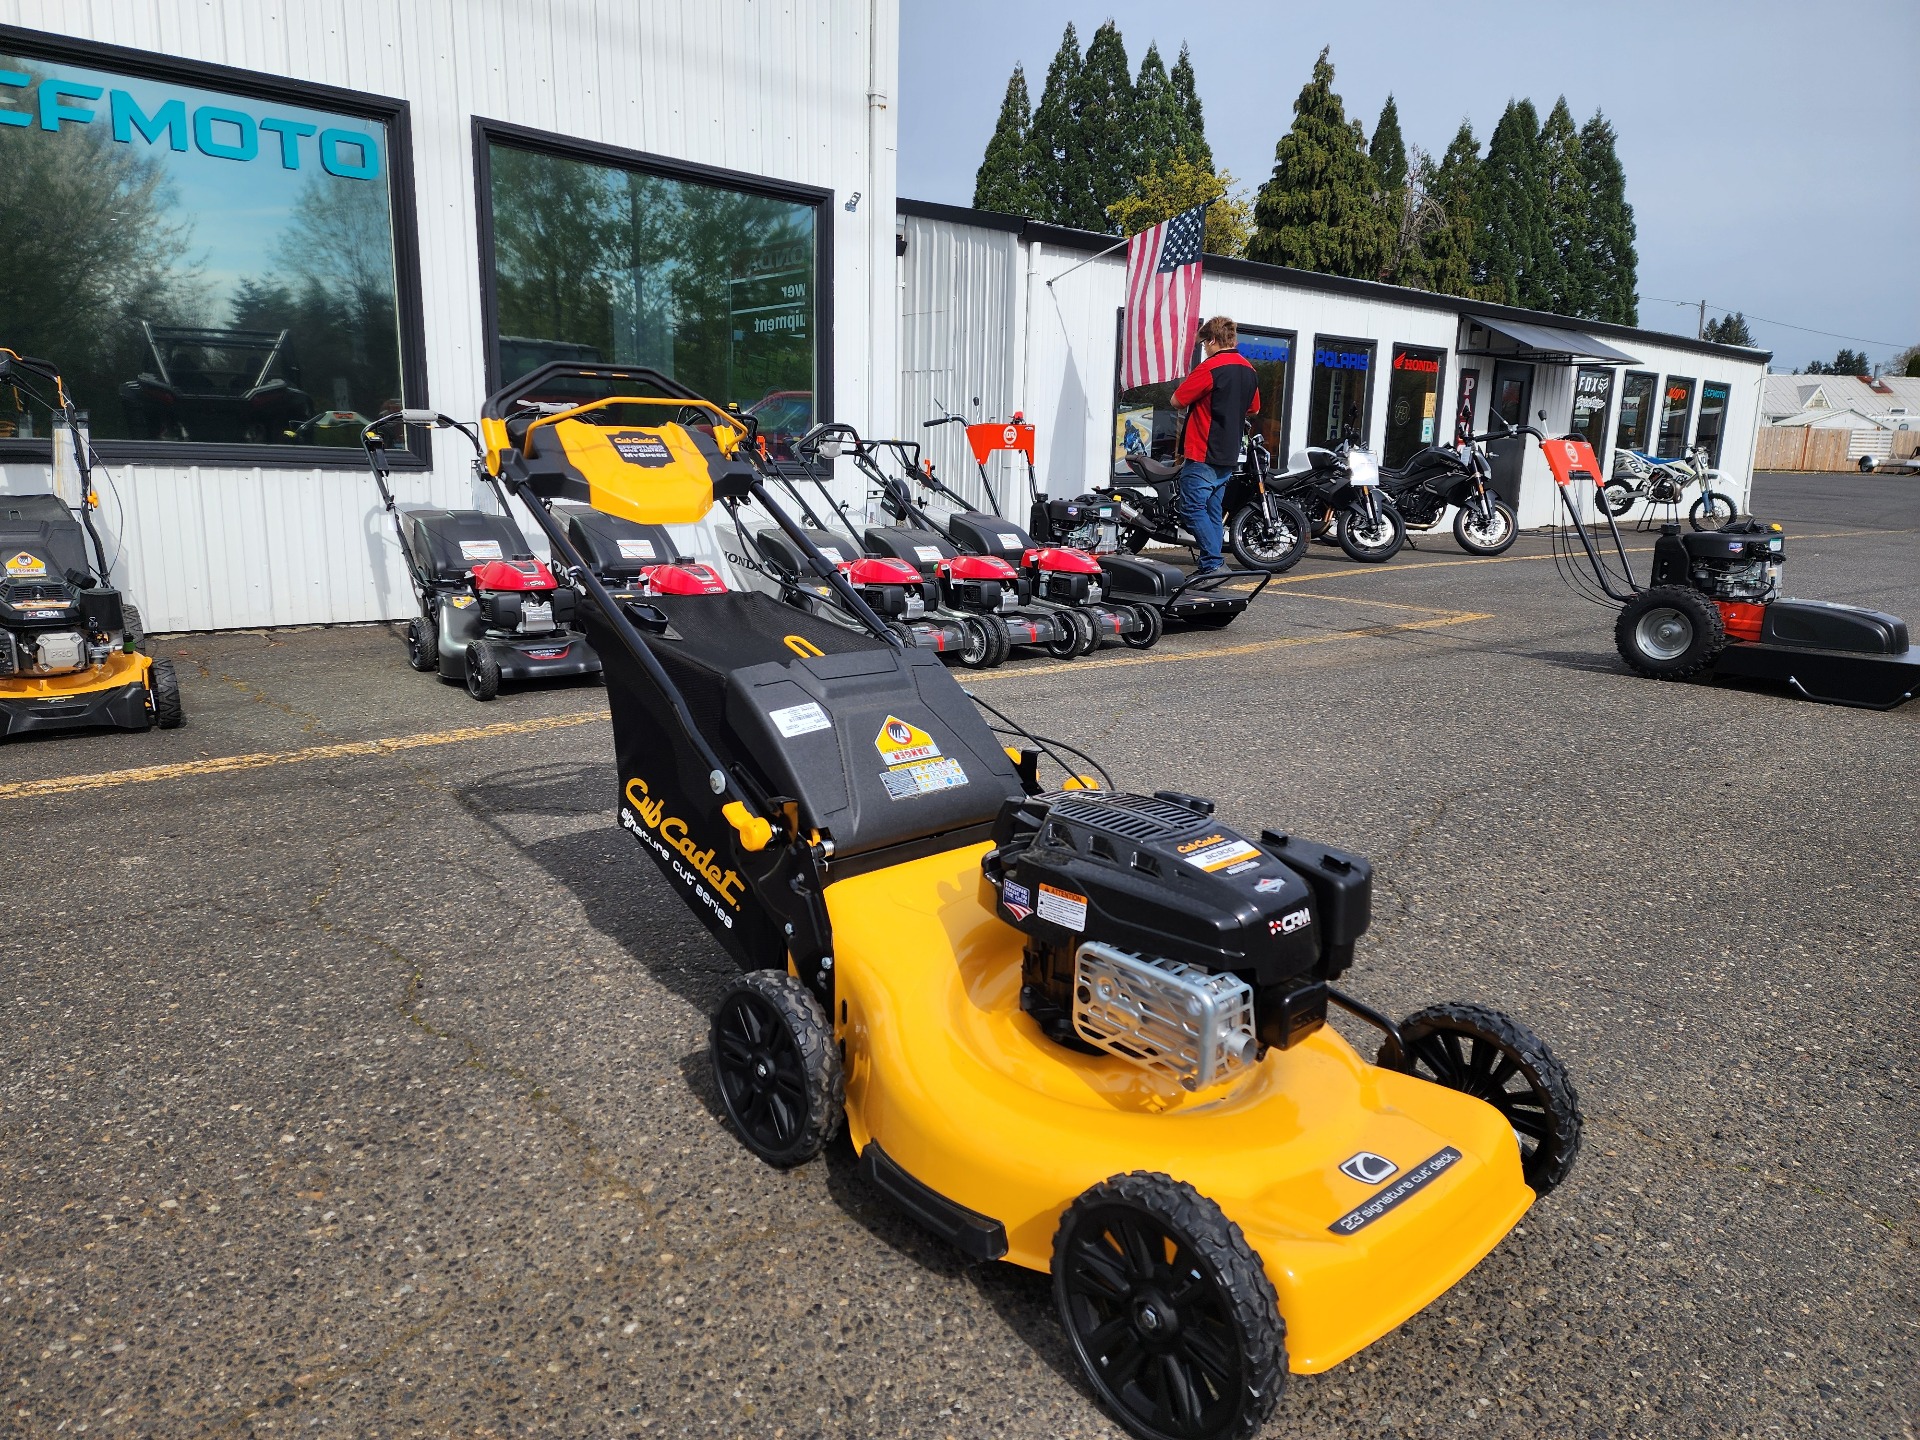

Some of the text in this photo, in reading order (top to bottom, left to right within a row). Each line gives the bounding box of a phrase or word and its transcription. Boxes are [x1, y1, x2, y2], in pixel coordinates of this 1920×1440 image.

[1315, 350, 1369, 371] POLARIS
[1405, 358, 1439, 372] HONDA
[1578, 376, 1599, 393] FOX
[893, 747, 931, 761] DANGER
[625, 777, 746, 907] Cub Cadet
[1177, 842, 1199, 854] Cub
[1194, 834, 1226, 848] Cadet
[621, 807, 733, 929] signature cut series
[1051, 887, 1082, 902] ATTENTION
[1281, 907, 1311, 932] CRM
[1361, 1181, 1414, 1218] signature
[1411, 1167, 1431, 1184] cut
[1429, 1153, 1457, 1171] deck
